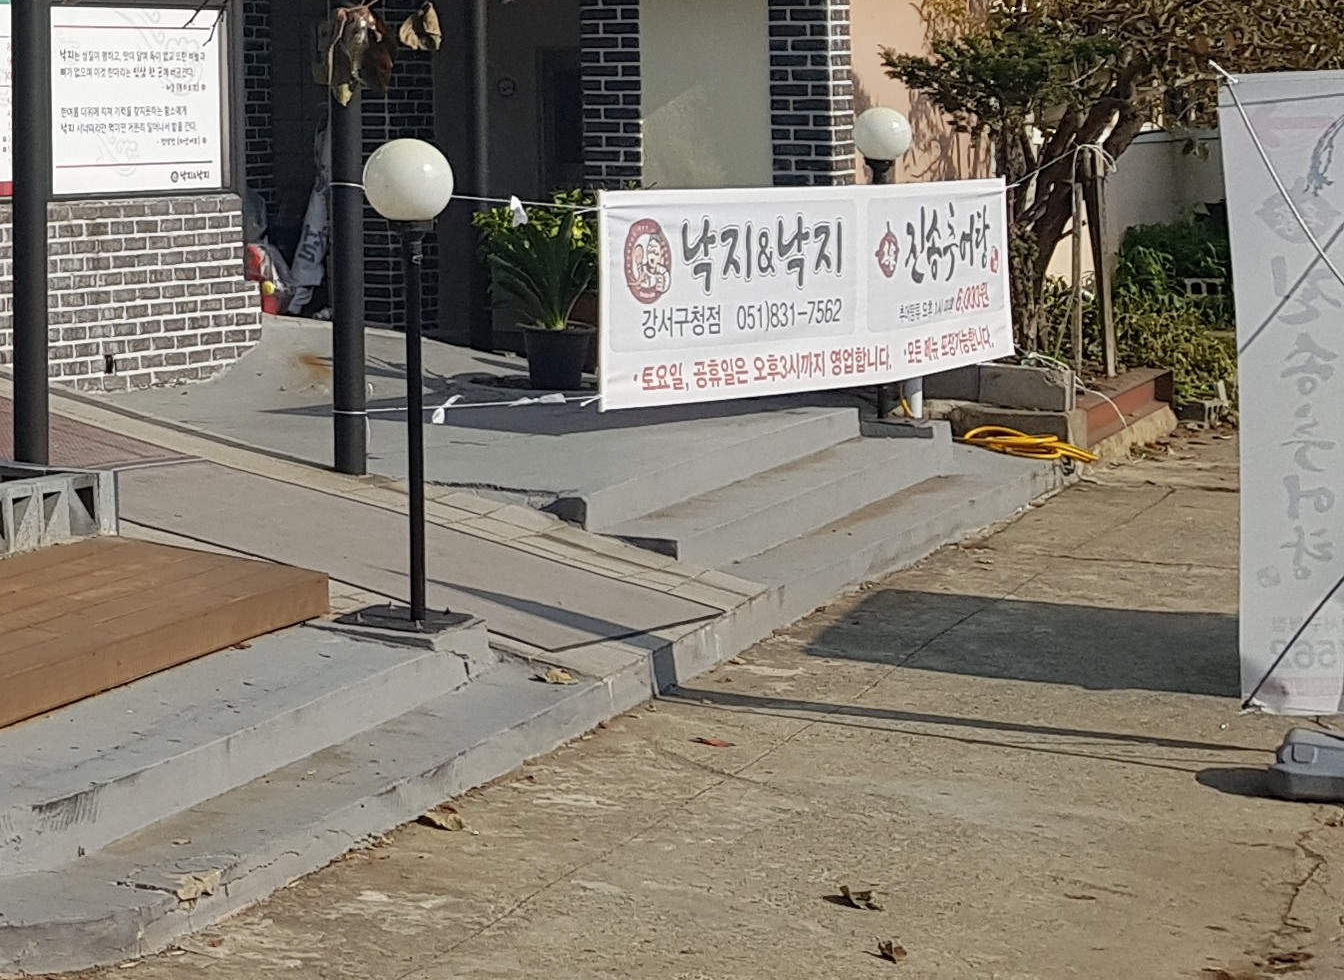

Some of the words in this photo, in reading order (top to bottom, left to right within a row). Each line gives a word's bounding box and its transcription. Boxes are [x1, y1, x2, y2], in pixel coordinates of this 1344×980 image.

[681, 212, 844, 295] 낙지&낙지
[642, 304, 721, 339] 강서구청점
[737, 298, 843, 332] 051)831-7562
[693, 357, 749, 389] 공휴일은
[829, 345, 892, 377] 영업합니다.
